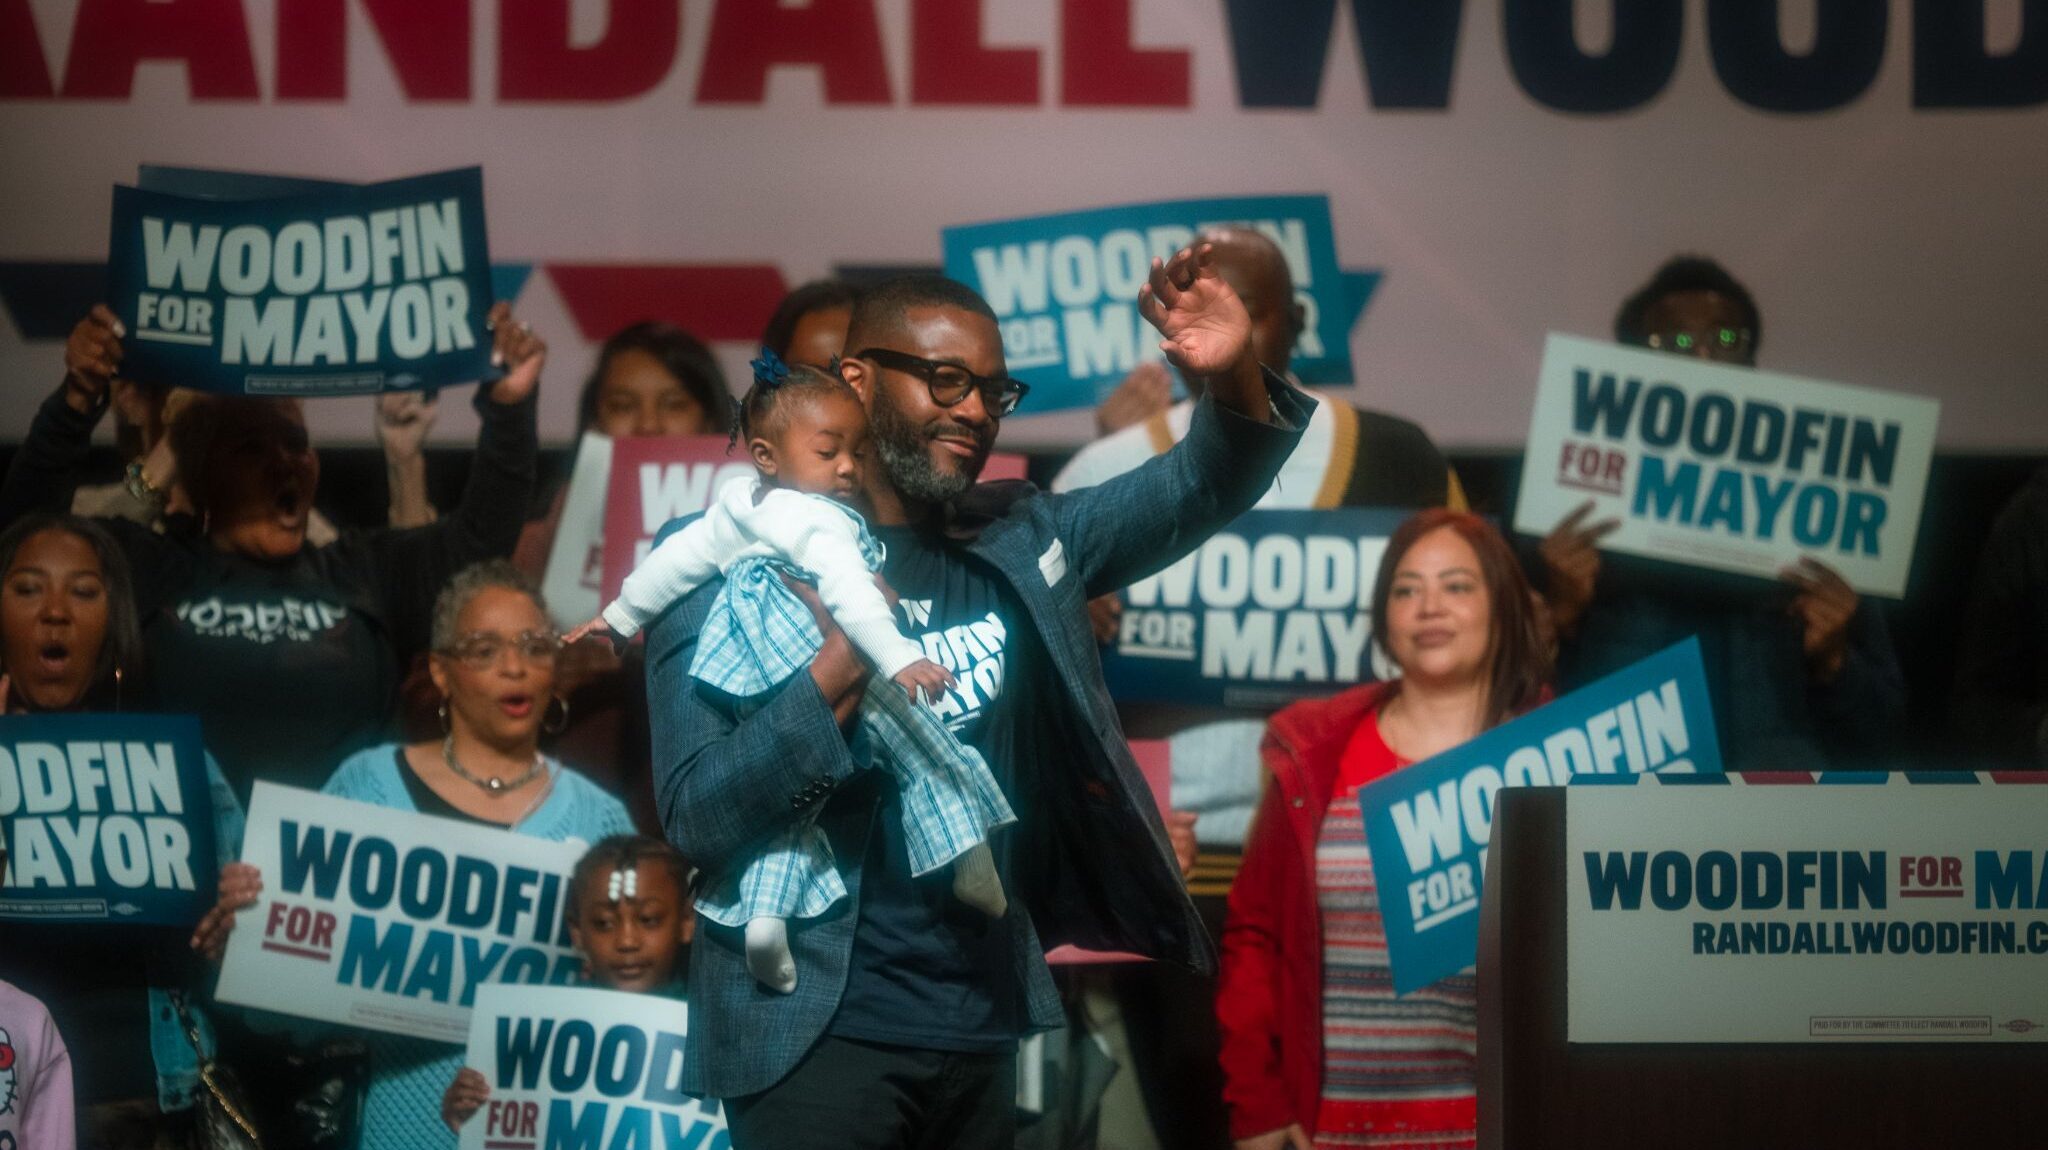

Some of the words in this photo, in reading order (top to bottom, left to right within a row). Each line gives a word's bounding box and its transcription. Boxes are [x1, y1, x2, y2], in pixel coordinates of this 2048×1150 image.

[143, 199, 465, 295] WOODFIN
[136, 292, 214, 335] FOR
[220, 276, 476, 366] MAYOR
[1573, 366, 1900, 487] WOODFIN
[1559, 440, 1626, 482] FOR
[1629, 453, 1889, 558] MAYOR
[1118, 611, 1196, 648] FOR
[1201, 609, 1401, 681] MAY
[1407, 862, 1475, 921] FOR
[1584, 850, 1887, 911] WOODFIN
[1900, 856, 1963, 887] FOR
[265, 901, 337, 949] FOR
[486, 1100, 540, 1138] FOR
